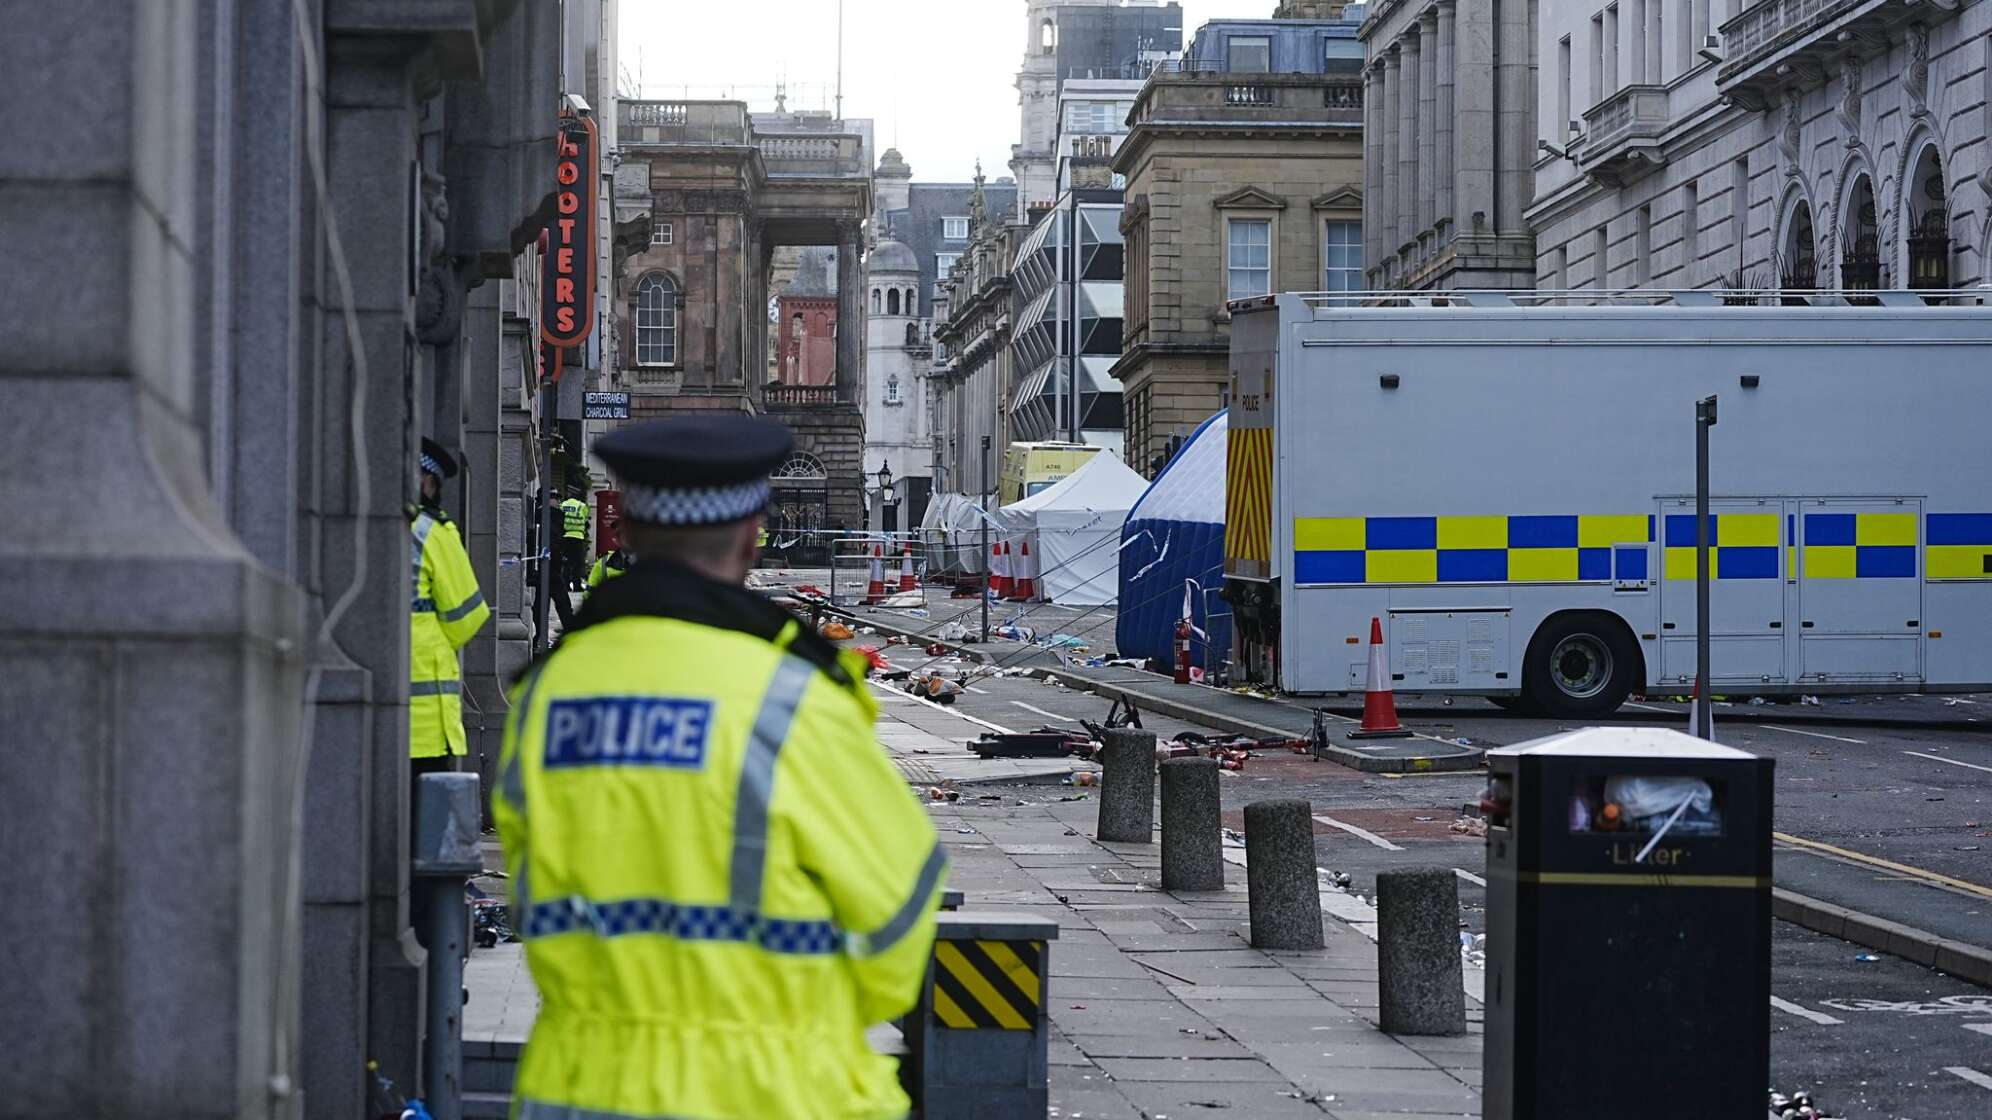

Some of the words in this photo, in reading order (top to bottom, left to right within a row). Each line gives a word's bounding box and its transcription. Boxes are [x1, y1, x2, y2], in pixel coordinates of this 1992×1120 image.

[557, 131, 580, 333] HOOTERS
[585, 392, 628, 404] MEDITERRANEAN
[1242, 394, 1260, 411] POLICE
[585, 407, 613, 418] CHARCOAL
[613, 407, 628, 418] GRILL
[551, 702, 706, 758] POLICE
